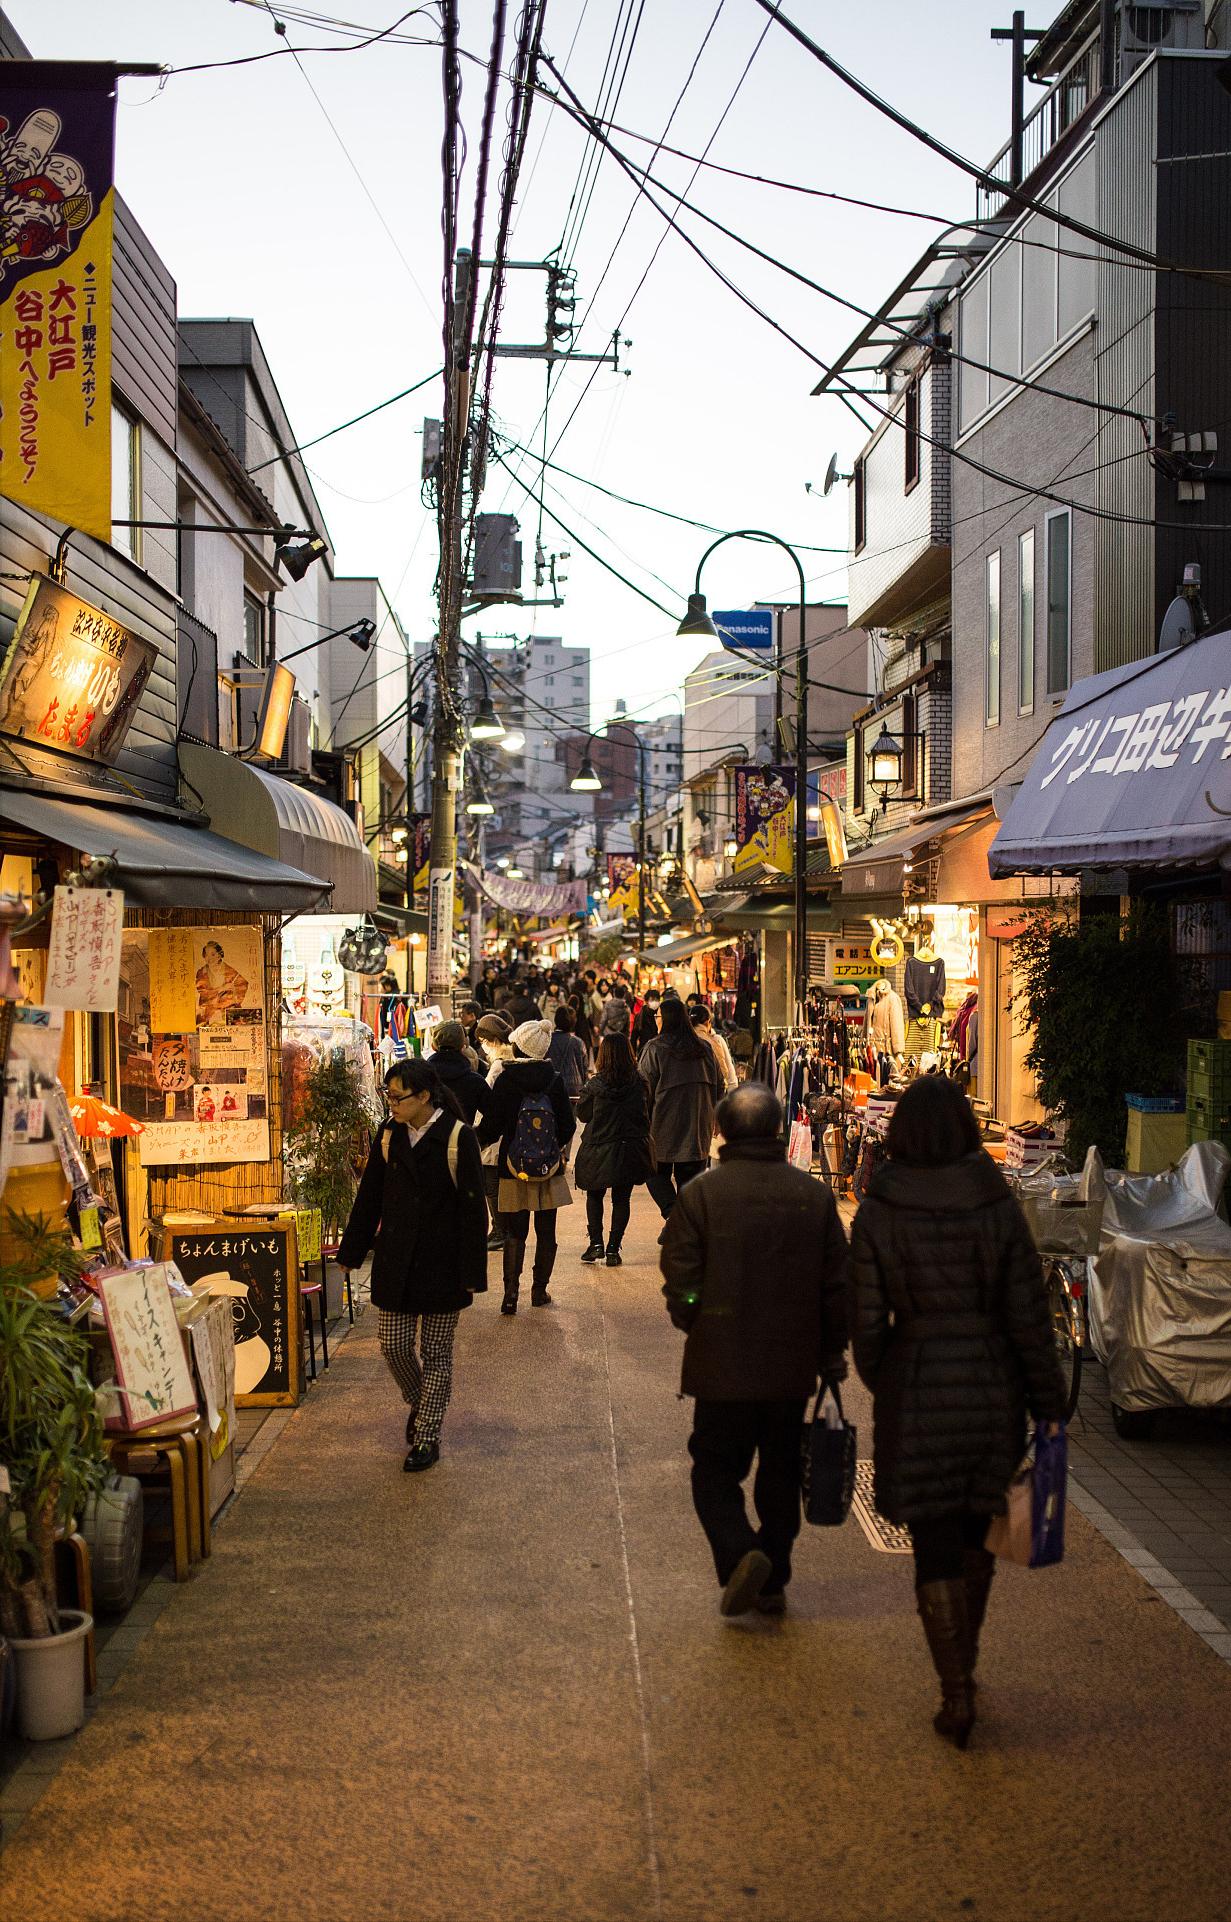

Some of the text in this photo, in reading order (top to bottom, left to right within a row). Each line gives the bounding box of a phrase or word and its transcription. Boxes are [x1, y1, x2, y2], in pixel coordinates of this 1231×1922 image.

[48, 279, 76, 380] 大江戸
[82, 278, 97, 427] ニュー観光スポット
[720, 624, 769, 634] anasonic
[37, 696, 96, 748] たまる
[1040, 685, 1231, 791] グリコ田辺牛
[170, 1042, 187, 1088] 夕焼け
[179, 1238, 279, 1258] ちょんまげいも
[136, 1270, 175, 1411] アイスキャンデー
